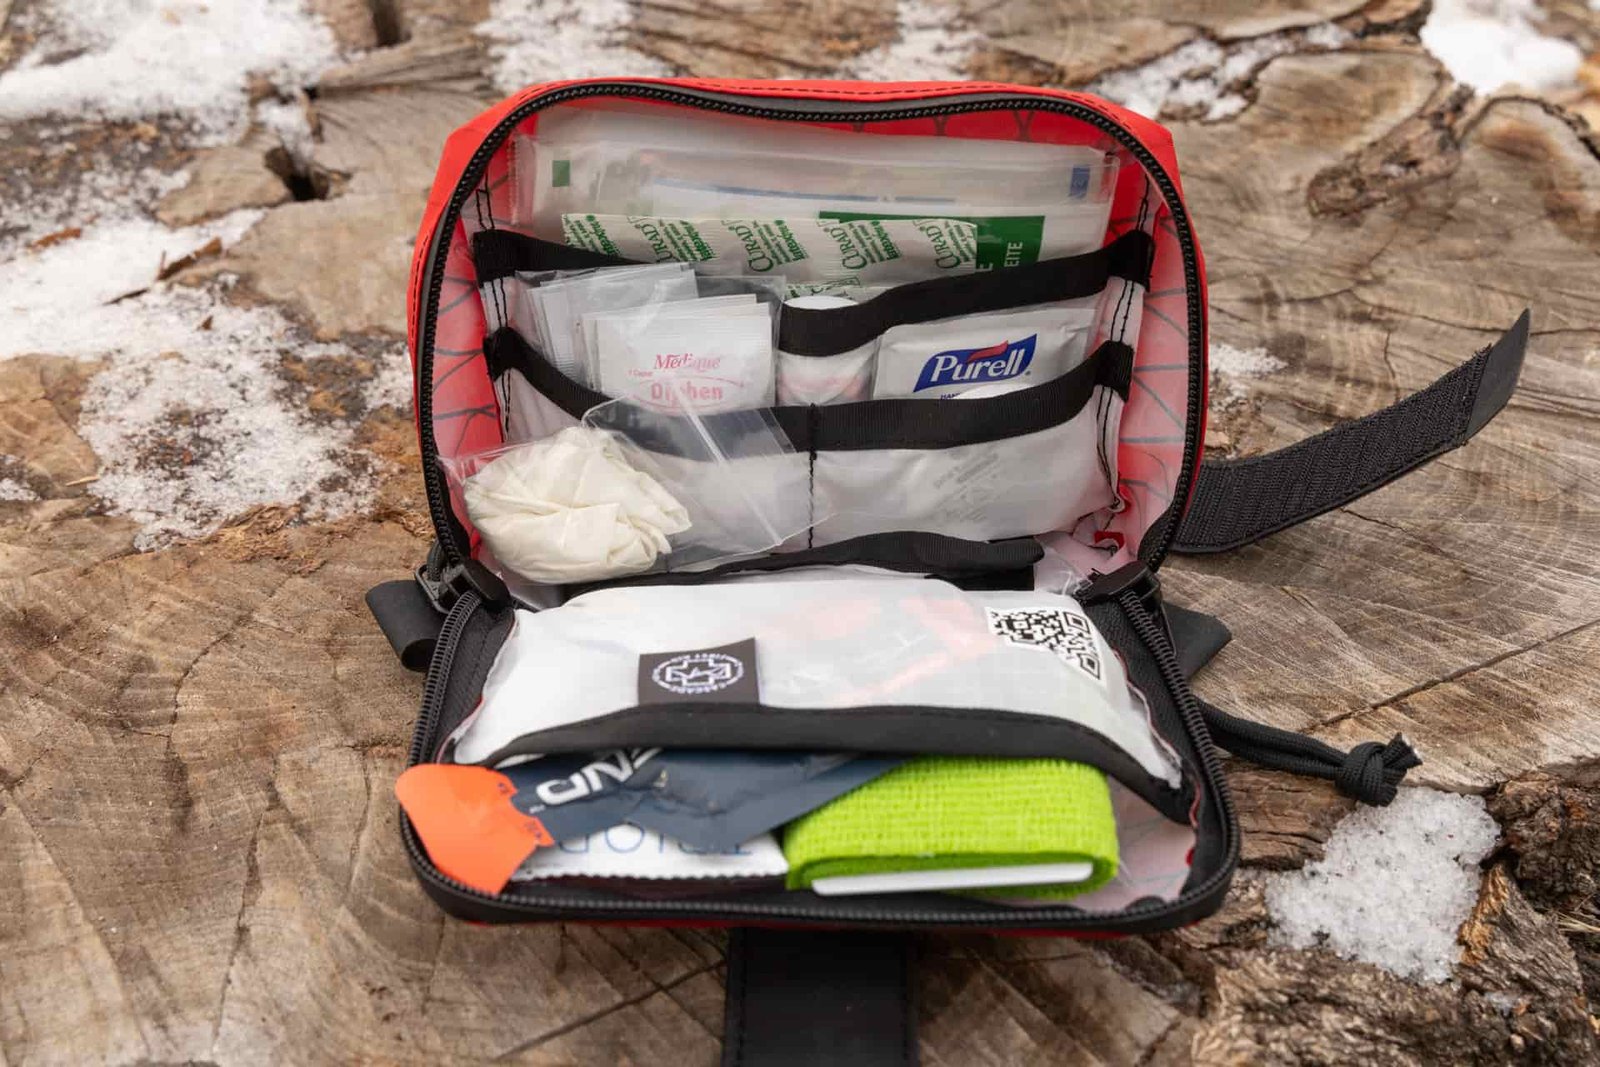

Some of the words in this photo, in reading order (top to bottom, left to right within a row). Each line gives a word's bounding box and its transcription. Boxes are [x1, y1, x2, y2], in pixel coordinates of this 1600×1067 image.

[641, 223, 680, 262] URAD
[735, 225, 773, 272] CURAD
[830, 227, 867, 269] CURAD
[926, 225, 961, 269] CURAD
[931, 349, 1025, 382] Purell
